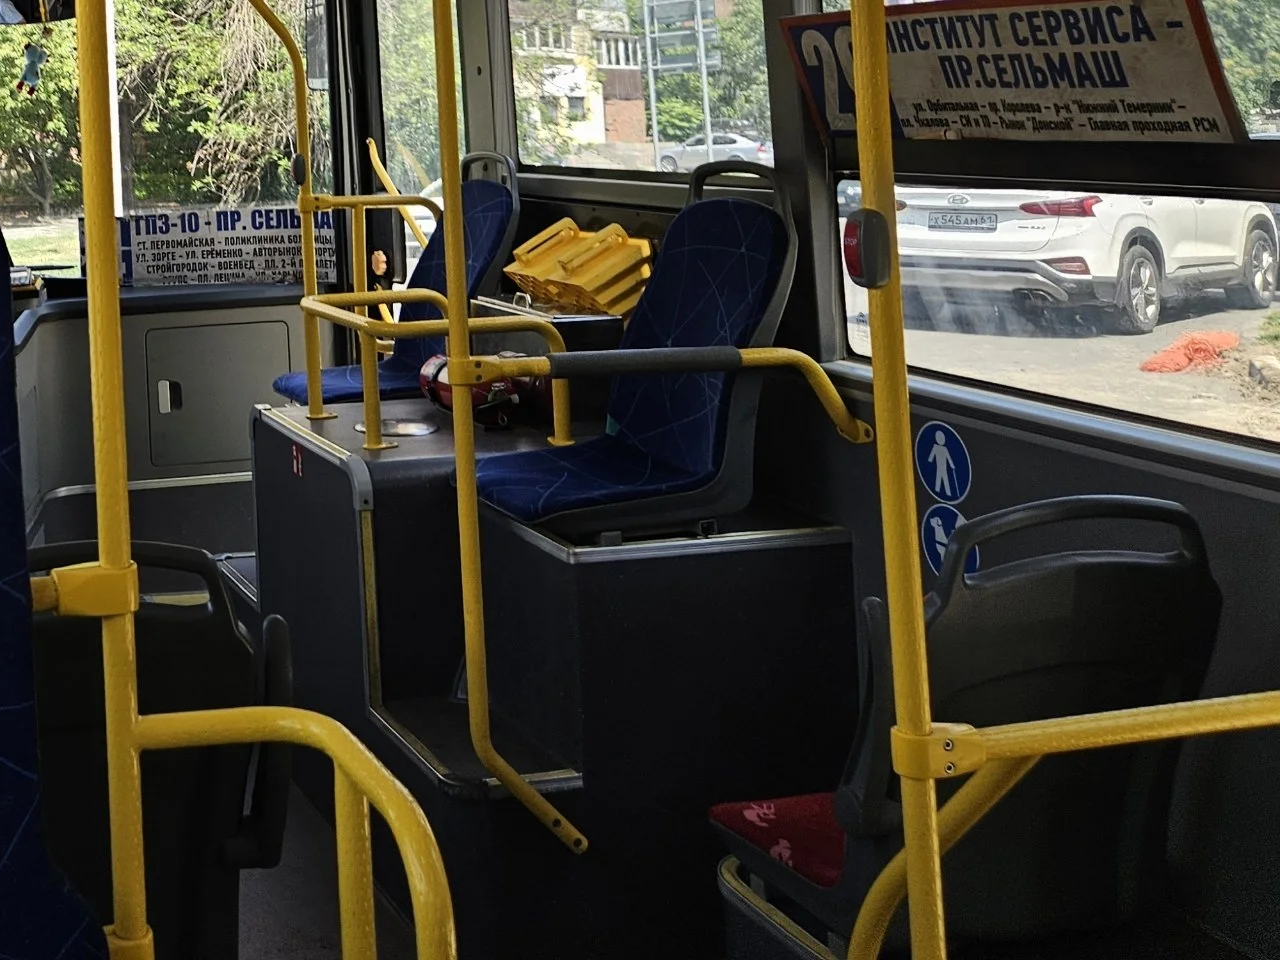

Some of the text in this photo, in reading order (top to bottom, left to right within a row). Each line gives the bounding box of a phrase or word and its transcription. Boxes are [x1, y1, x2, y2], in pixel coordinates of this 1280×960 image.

[1008, 4, 1157, 47] СЕРВИСА
[938, 50, 1129, 89] ПР.СЕЛЬМАШ
[912, 102, 926, 116] ул.
[926, 99, 980, 115] Орбитальная
[1000, 99, 1042, 116] Королева
[914, 115, 950, 128] Чкалова
[999, 116, 1026, 129] Рынок
[1087, 117, 1131, 131] Главная
[1131, 118, 1192, 135] проходная
[1192, 116, 1221, 133] РСМ
[135, 212, 200, 236] ГПЗ-10
[216, 210, 247, 231] ПР.
[137, 241, 148, 251] СТ.
[150, 237, 215, 250] ПЕРВОМАЙСКАЯ
[224, 235, 285, 246] ПОЛИКЛИНИКА
[136, 253, 149, 263] УЛ.
[151, 251, 176, 262] ЗОРГЕ
[185, 250, 199, 260] УЛ.
[201, 248, 243, 259] ЕРЁМЕНКО
[253, 246, 302, 257] АВТОРЫНОК
[146, 261, 209, 274] СТРОЙГОРОДОК
[218, 260, 255, 270] ВОЕНВЕД
[264, 259, 279, 269] ПЛ.
[281, 257, 296, 269] 2-Й
[197, 274, 211, 283] ПЛ.
